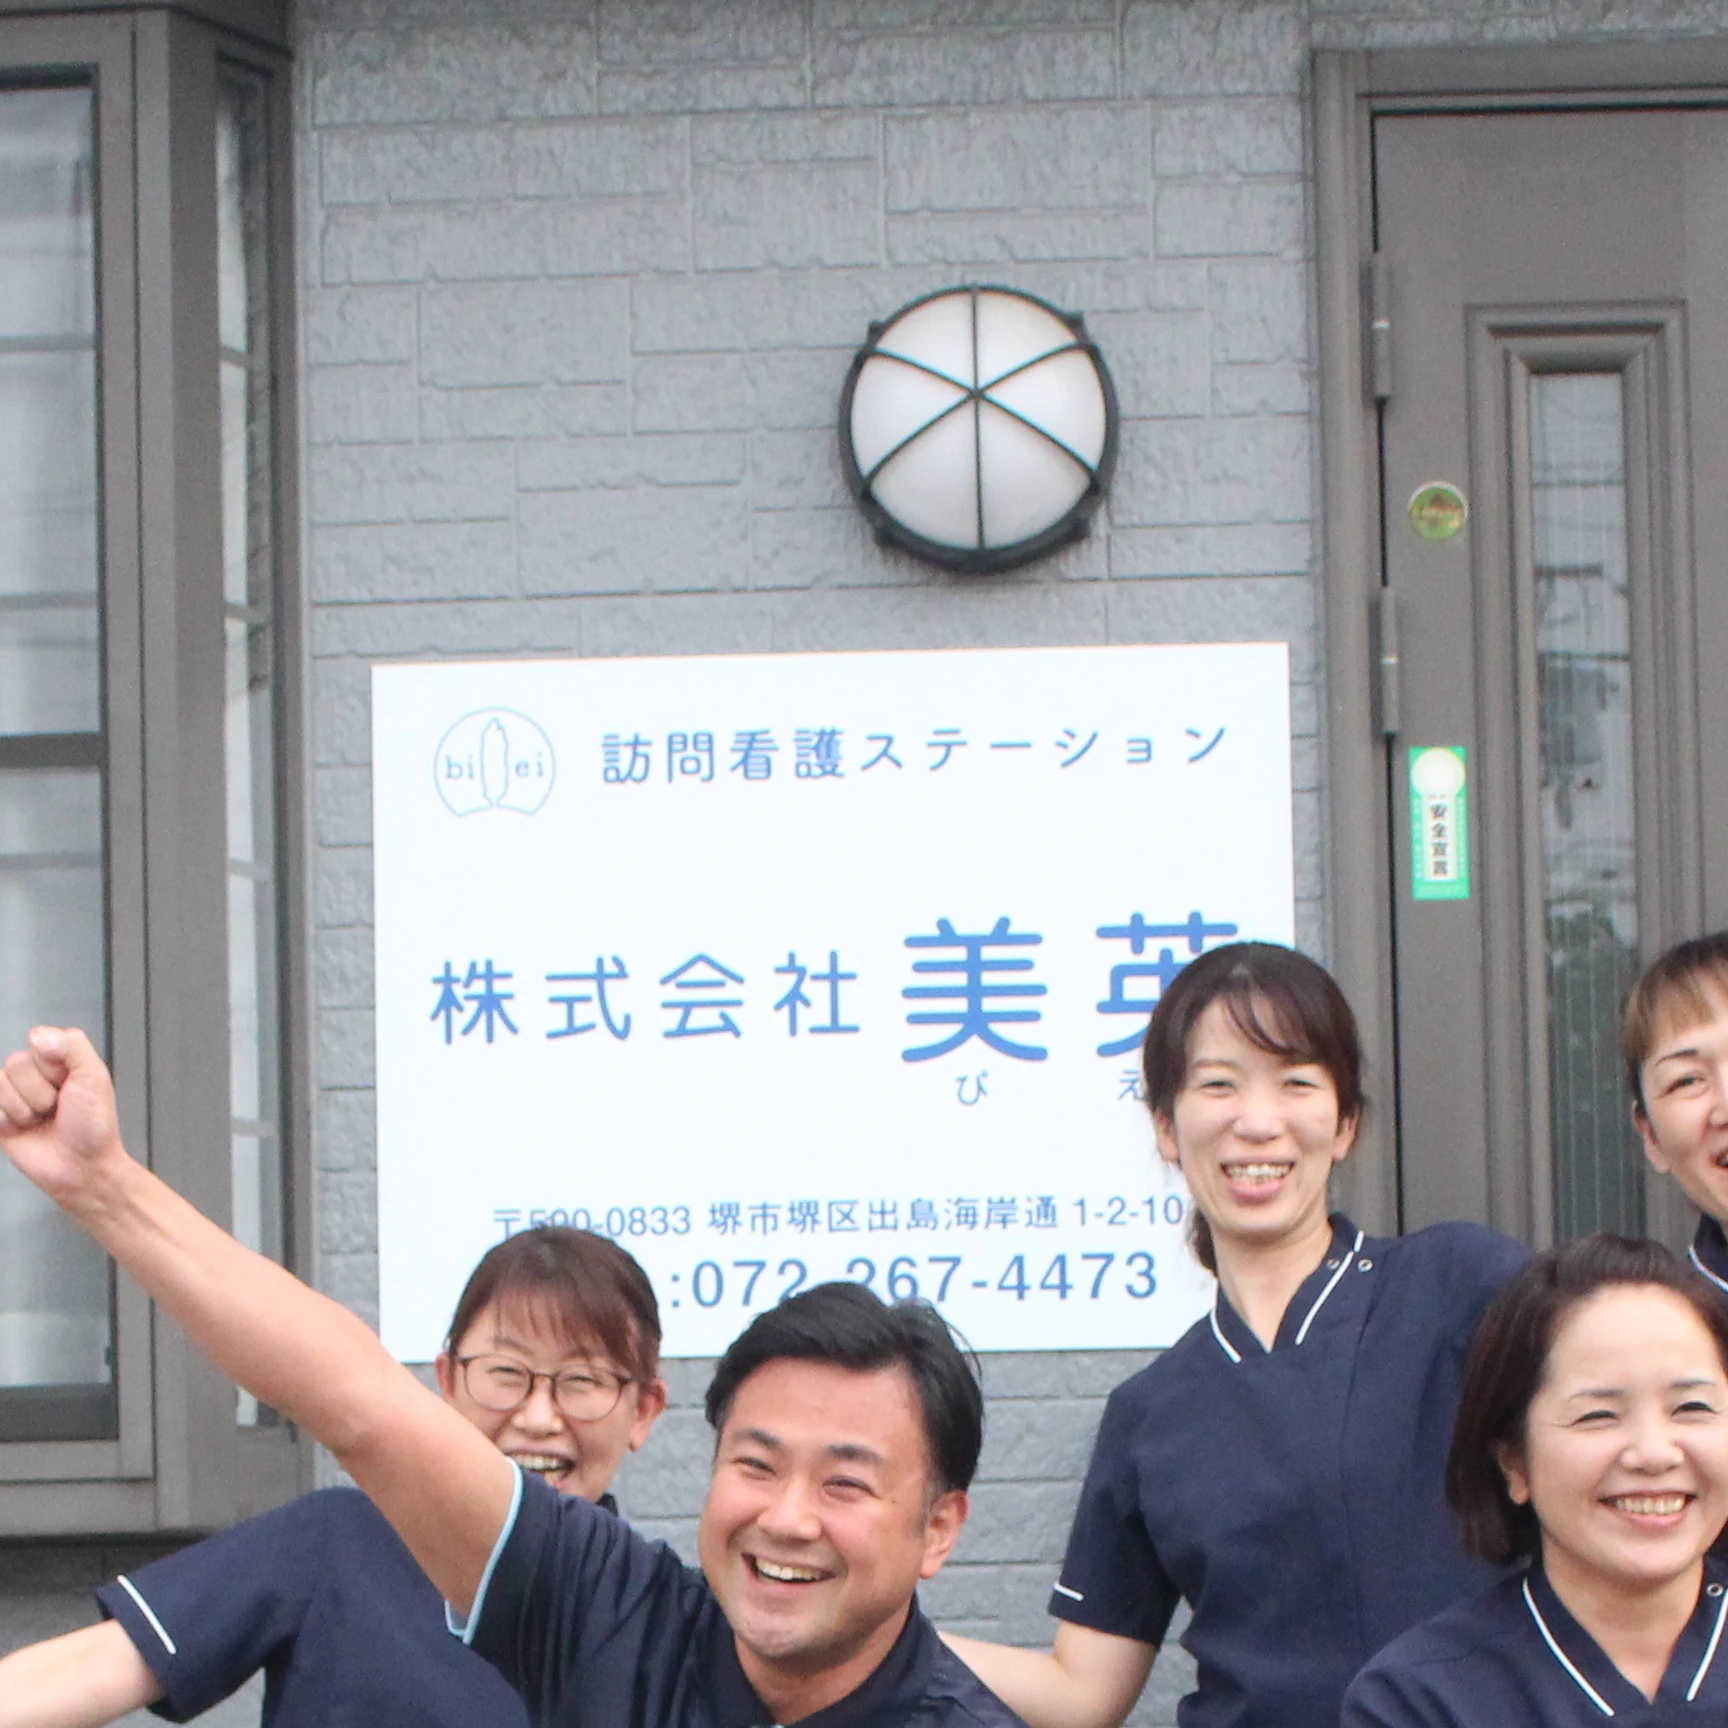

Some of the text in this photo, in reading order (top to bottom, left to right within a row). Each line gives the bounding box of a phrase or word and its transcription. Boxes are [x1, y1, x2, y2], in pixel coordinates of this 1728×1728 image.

[444, 752, 475, 780] bi
[601, 726, 1227, 784] 訪問看護ステーション
[671, 1249, 1159, 1308] :072267-4473
